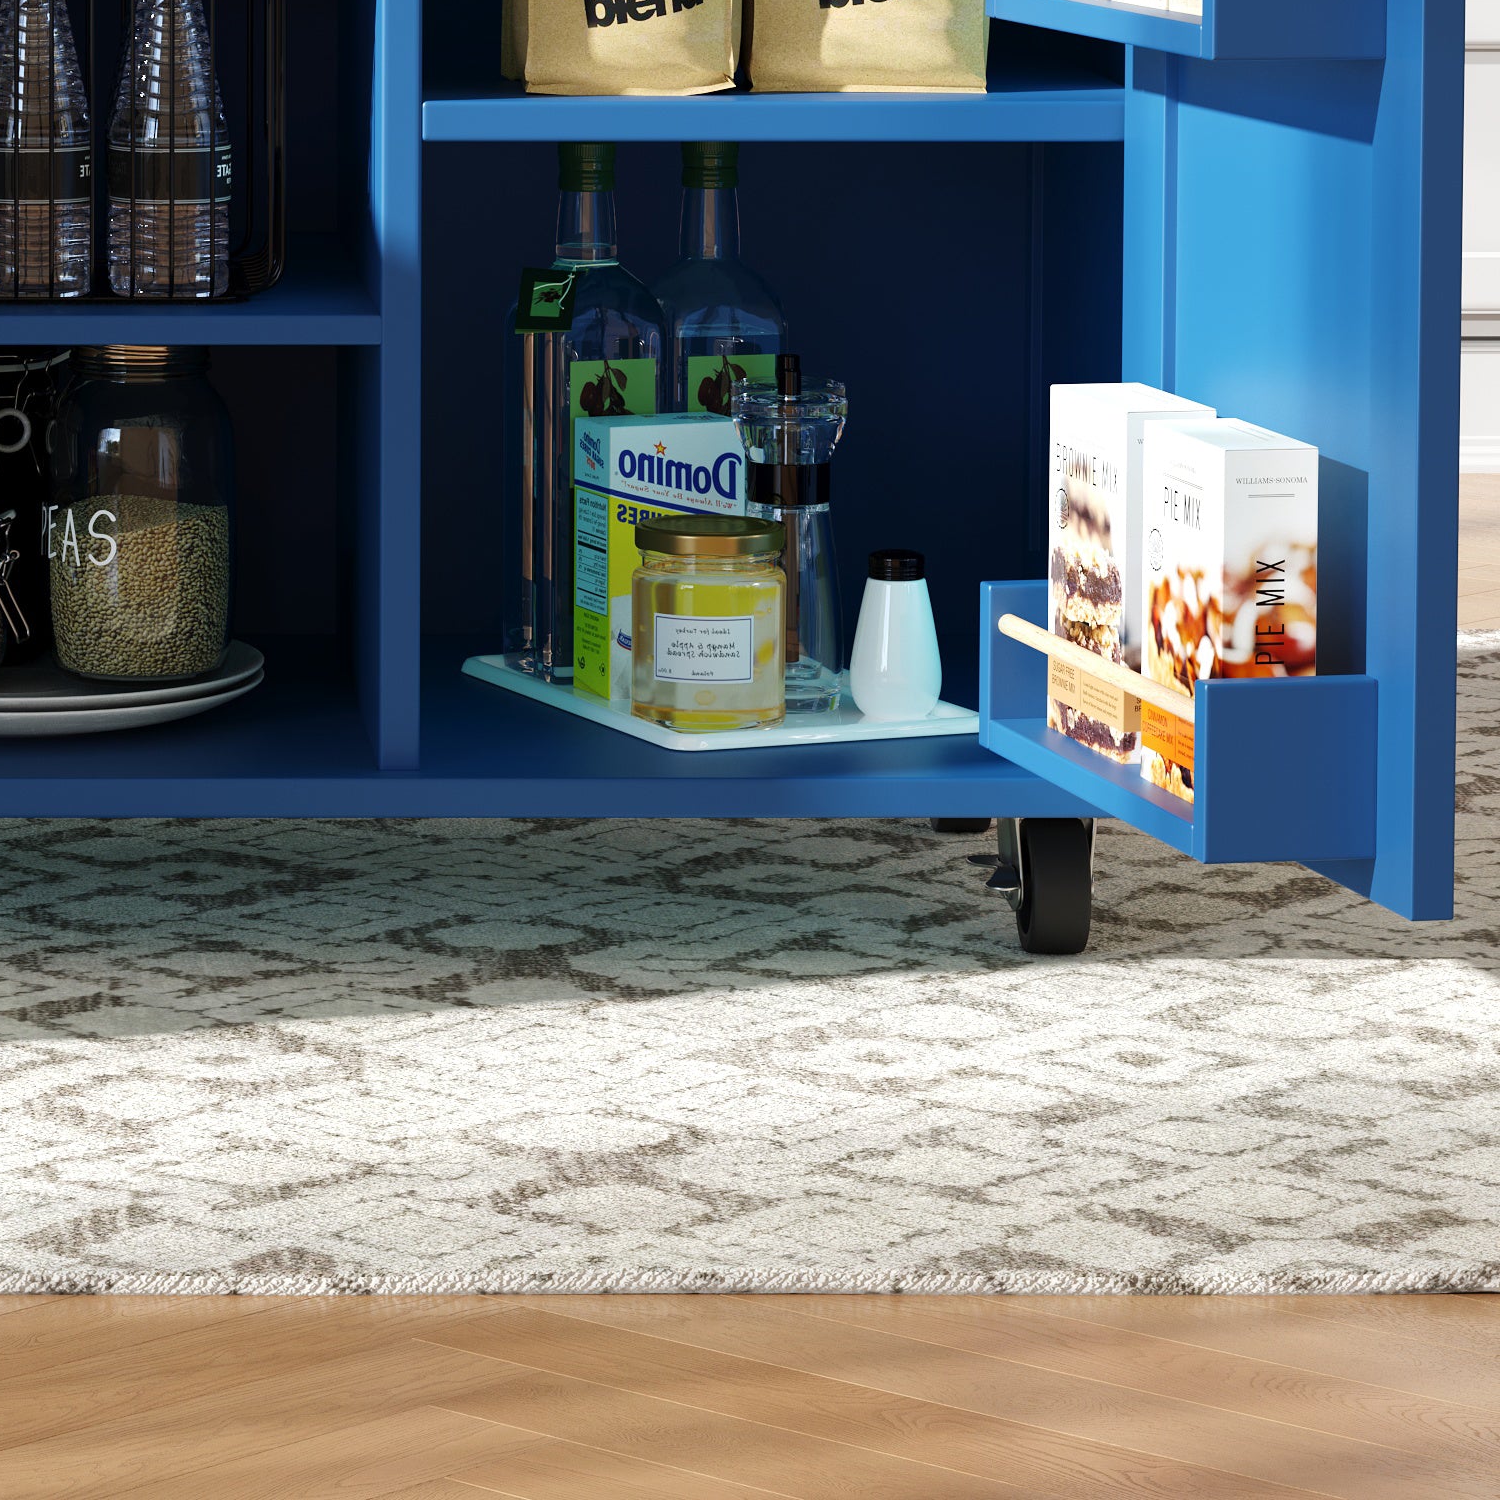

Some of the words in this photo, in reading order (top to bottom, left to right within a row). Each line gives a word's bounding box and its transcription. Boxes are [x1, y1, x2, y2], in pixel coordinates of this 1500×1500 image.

[1056, 442, 1097, 487] BROWNIE
[1101, 460, 1118, 494] MIX
[1164, 486, 1179, 521] PIE
[1183, 494, 1201, 530] MIX
[41, 501, 117, 566] PEAS
[1255, 560, 1285, 606] MIX
[1255, 623, 1285, 665] PIE
